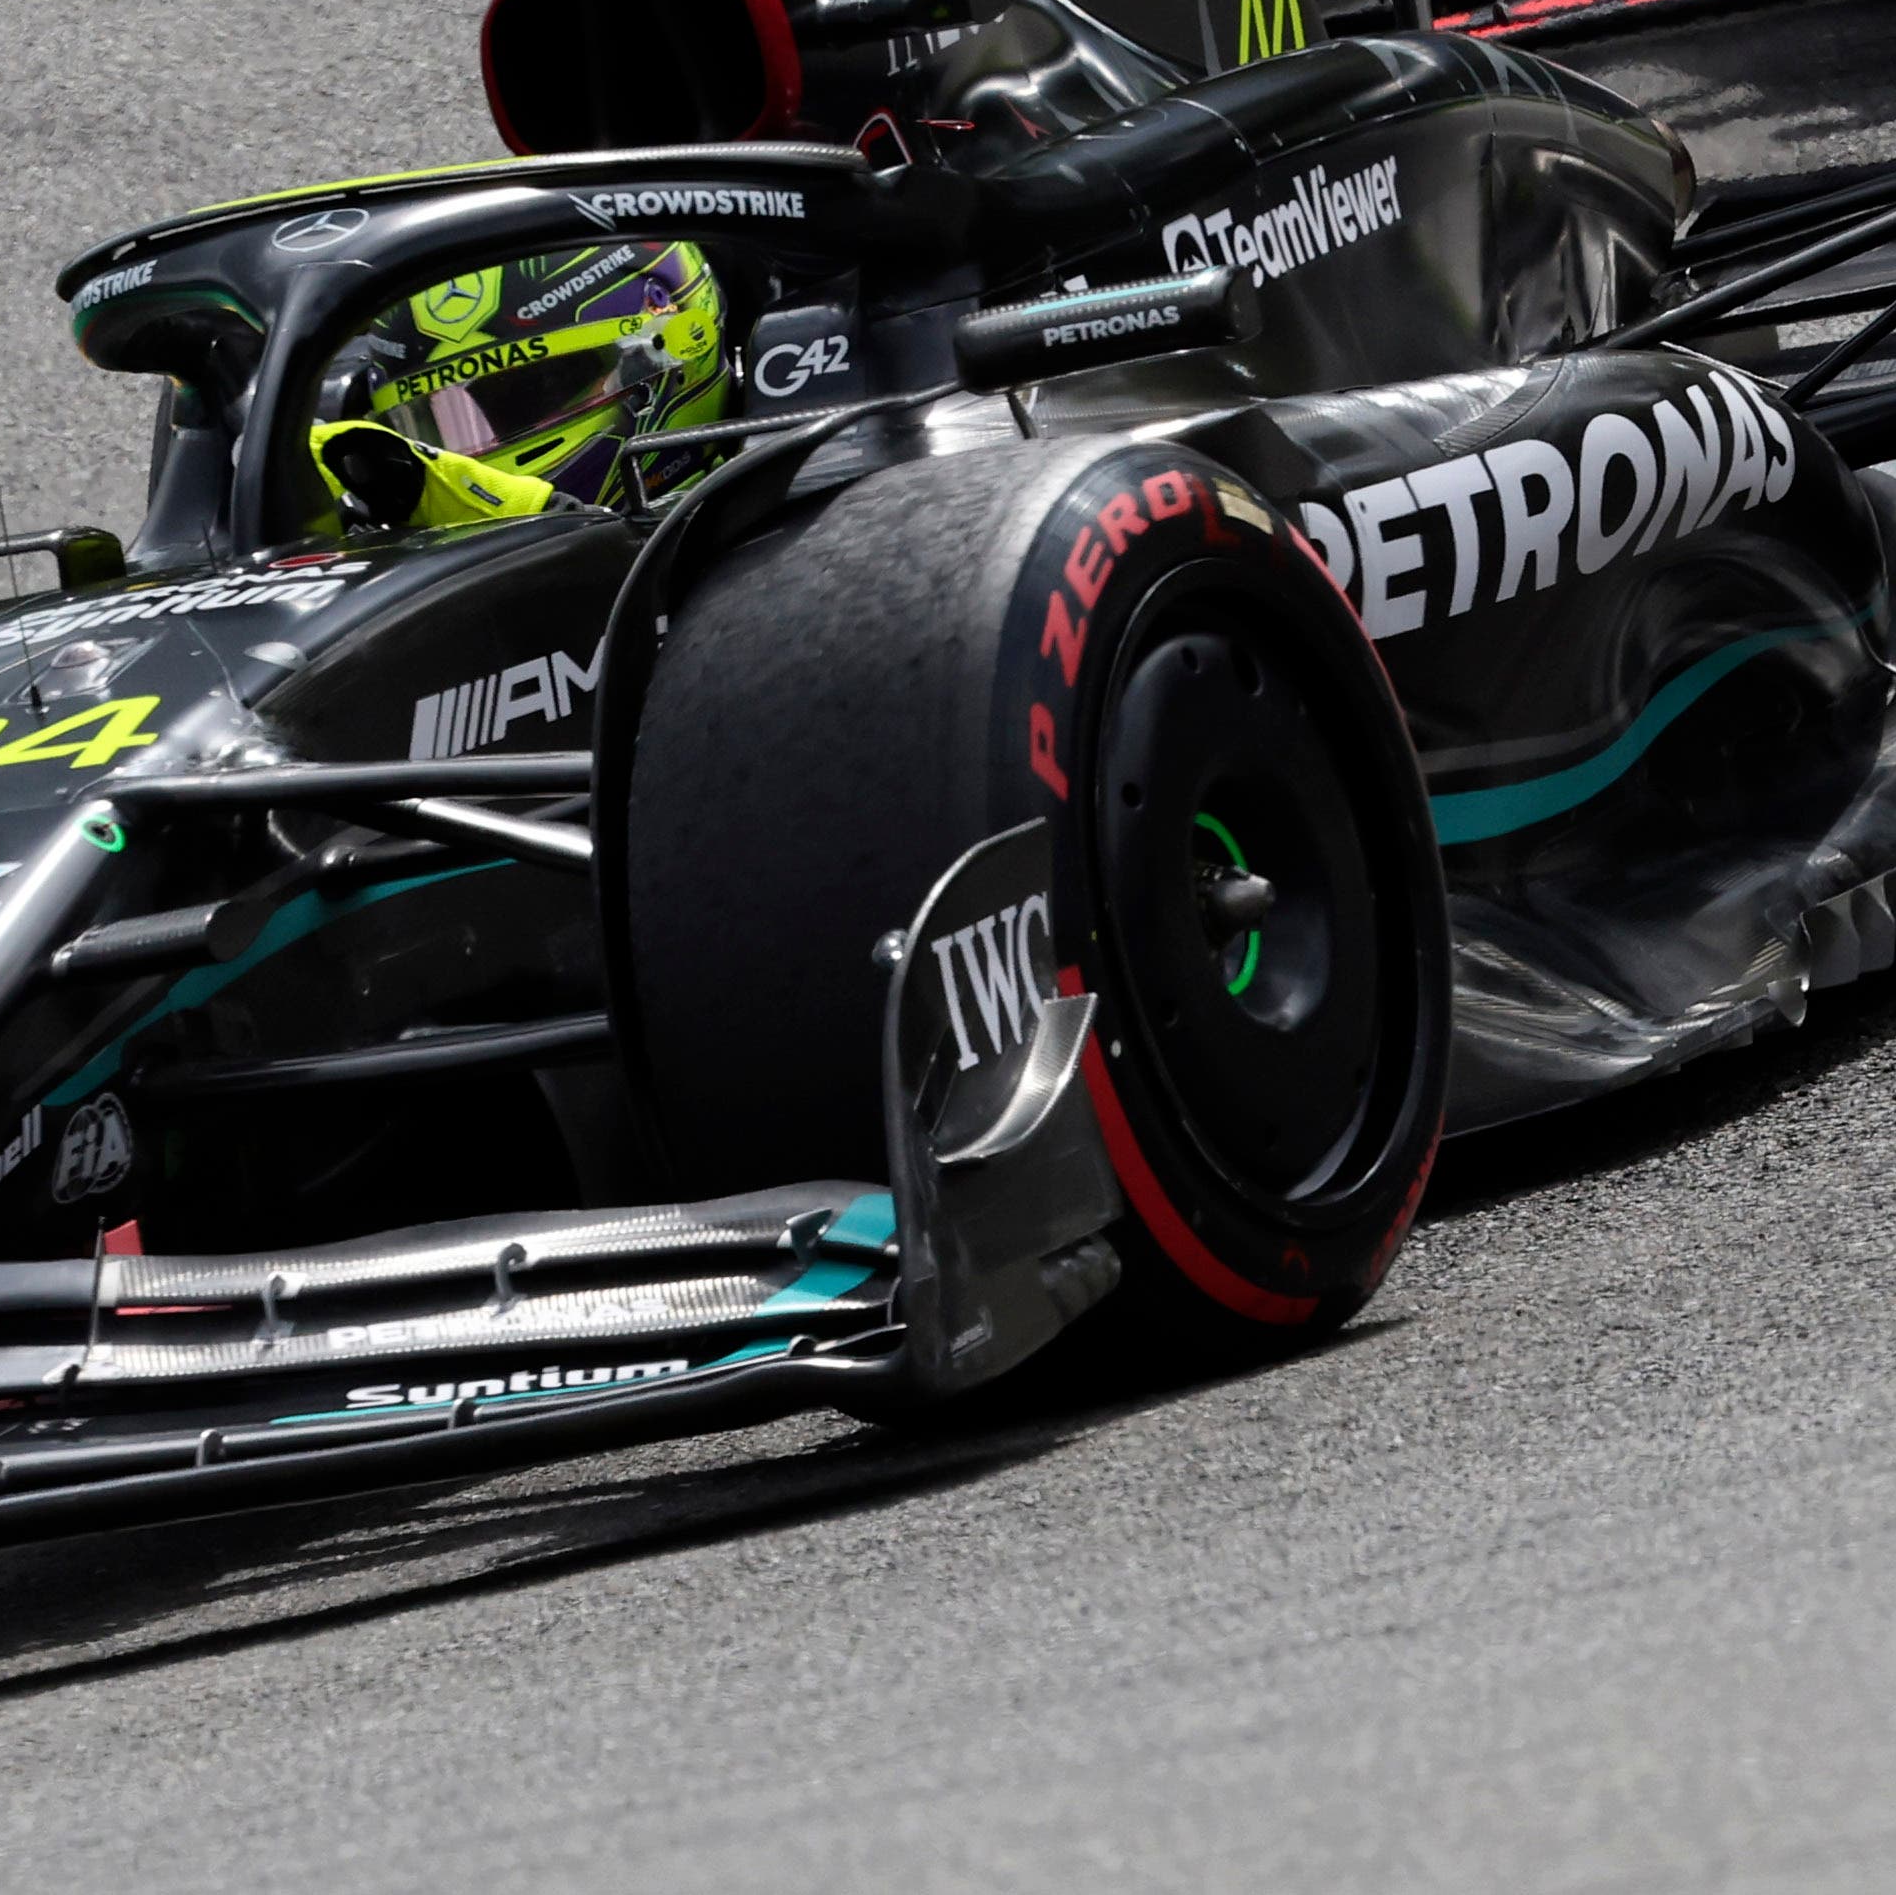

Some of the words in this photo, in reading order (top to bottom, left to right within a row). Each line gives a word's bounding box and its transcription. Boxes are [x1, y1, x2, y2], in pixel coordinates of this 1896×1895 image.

[591, 189, 805, 219] CROWDSTRIKE
[1205, 154, 1404, 288] TeamViewer
[516, 244, 637, 321] CROWDSTRIKE
[1043, 305, 1181, 348] PETRONAS
[395, 336, 550, 404] PETRONAS
[753, 334, 850, 397] G42
[1300, 368, 1797, 640] PETRONAS
[7, 560, 373, 629] PETRONAS
[1039, 469, 1195, 689] ZERO
[1029, 702, 1069, 802] P
[930, 890, 1058, 1071] IWC
[345, 1359, 689, 1410] Syntium
